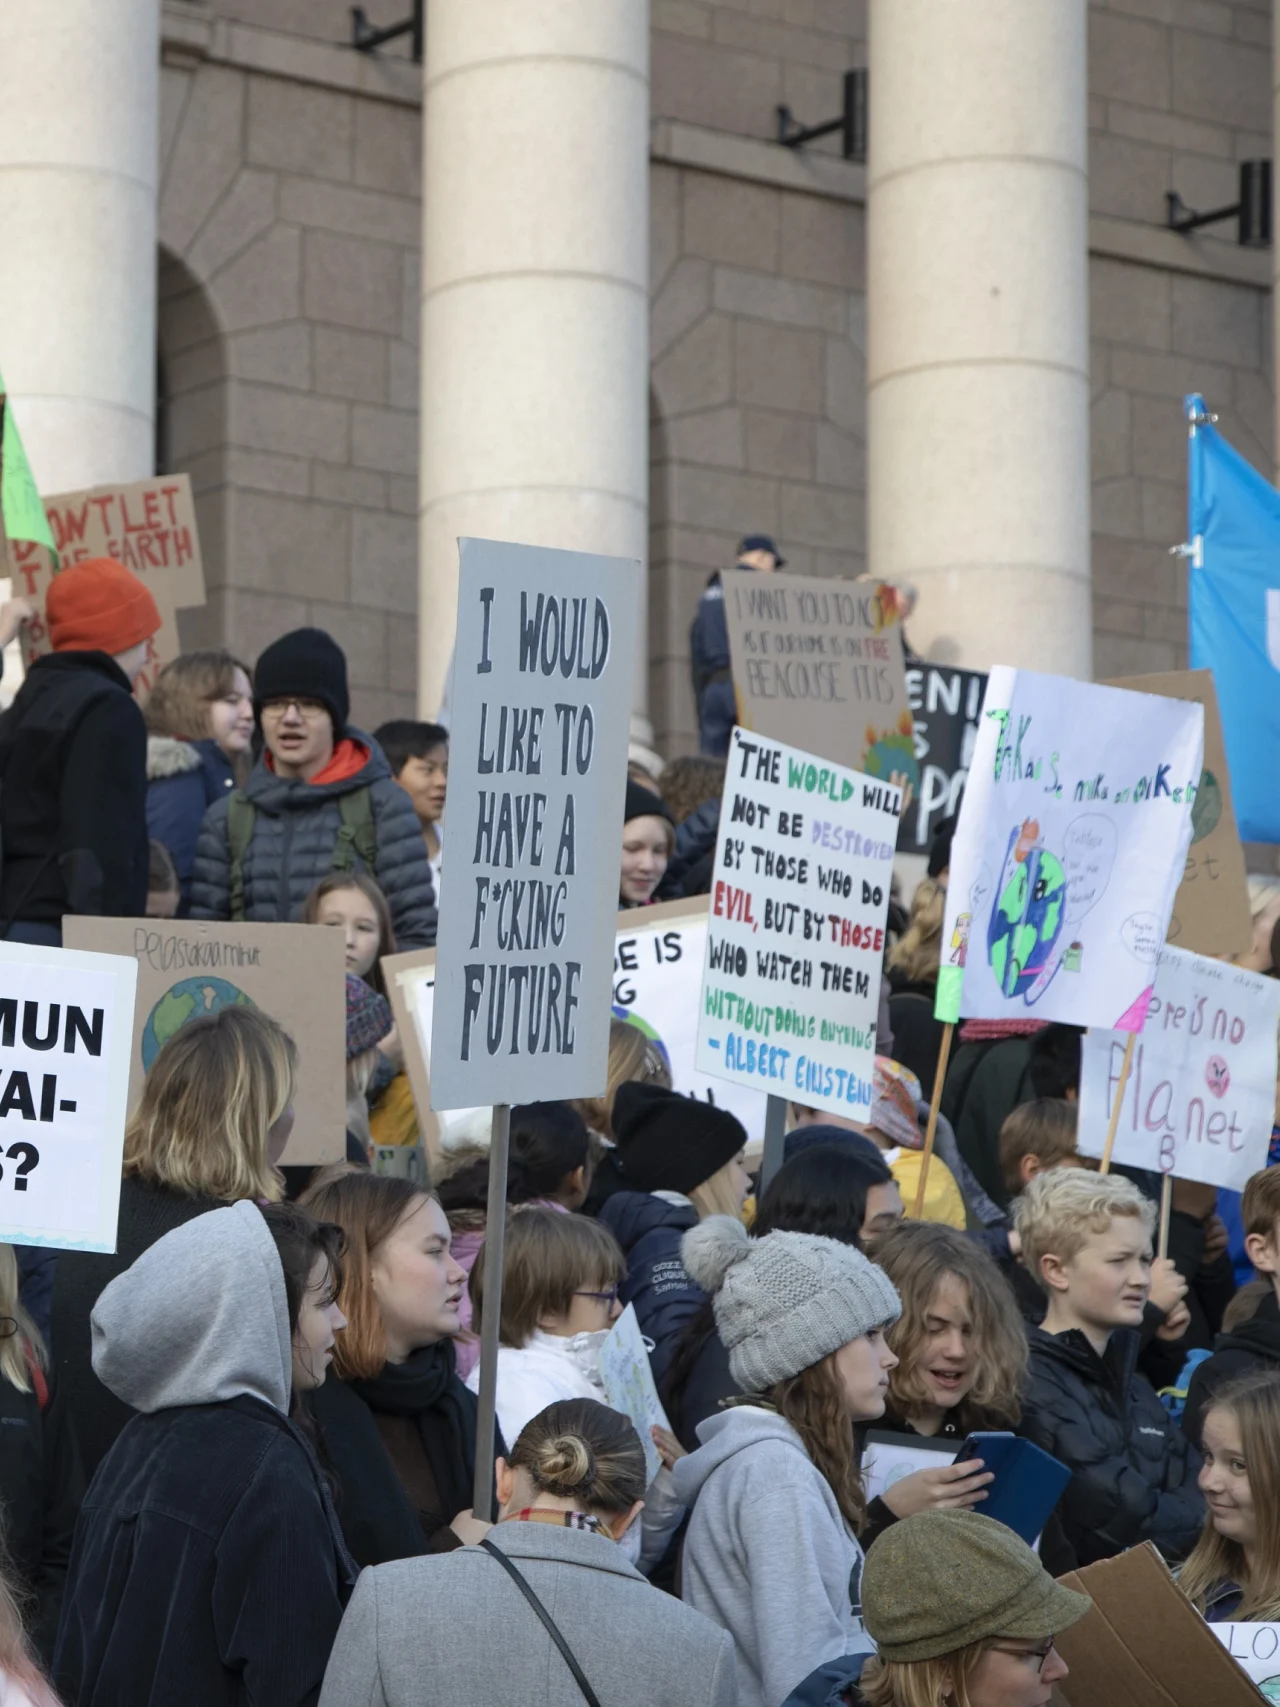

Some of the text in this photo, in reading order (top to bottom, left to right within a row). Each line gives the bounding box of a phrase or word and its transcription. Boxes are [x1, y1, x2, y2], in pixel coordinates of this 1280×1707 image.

[120, 484, 181, 533] LET
[477, 587, 611, 680] I WOULD
[477, 702, 595, 776] LIKE TO
[787, 756, 856, 802] WORLD
[862, 784, 901, 818] WILL
[473, 790, 576, 876] HAVE A
[730, 793, 896, 861] NOT BE DESTROYED
[723, 837, 883, 907] BY THOSE WHO DO
[654, 931, 683, 965] IS
[713, 879, 885, 952] EVIL, BUT BY THOSE
[708, 934, 871, 999] WHO WATCH THEM
[461, 961, 582, 1062] FUTURE
[705, 984, 775, 1038] WITHOUT
[775, 1005, 816, 1038] DOING
[725, 1031, 792, 1082] ALBERT
[794, 1054, 872, 1107] EINSTEIN
[1106, 1039, 1247, 1153] Planet
